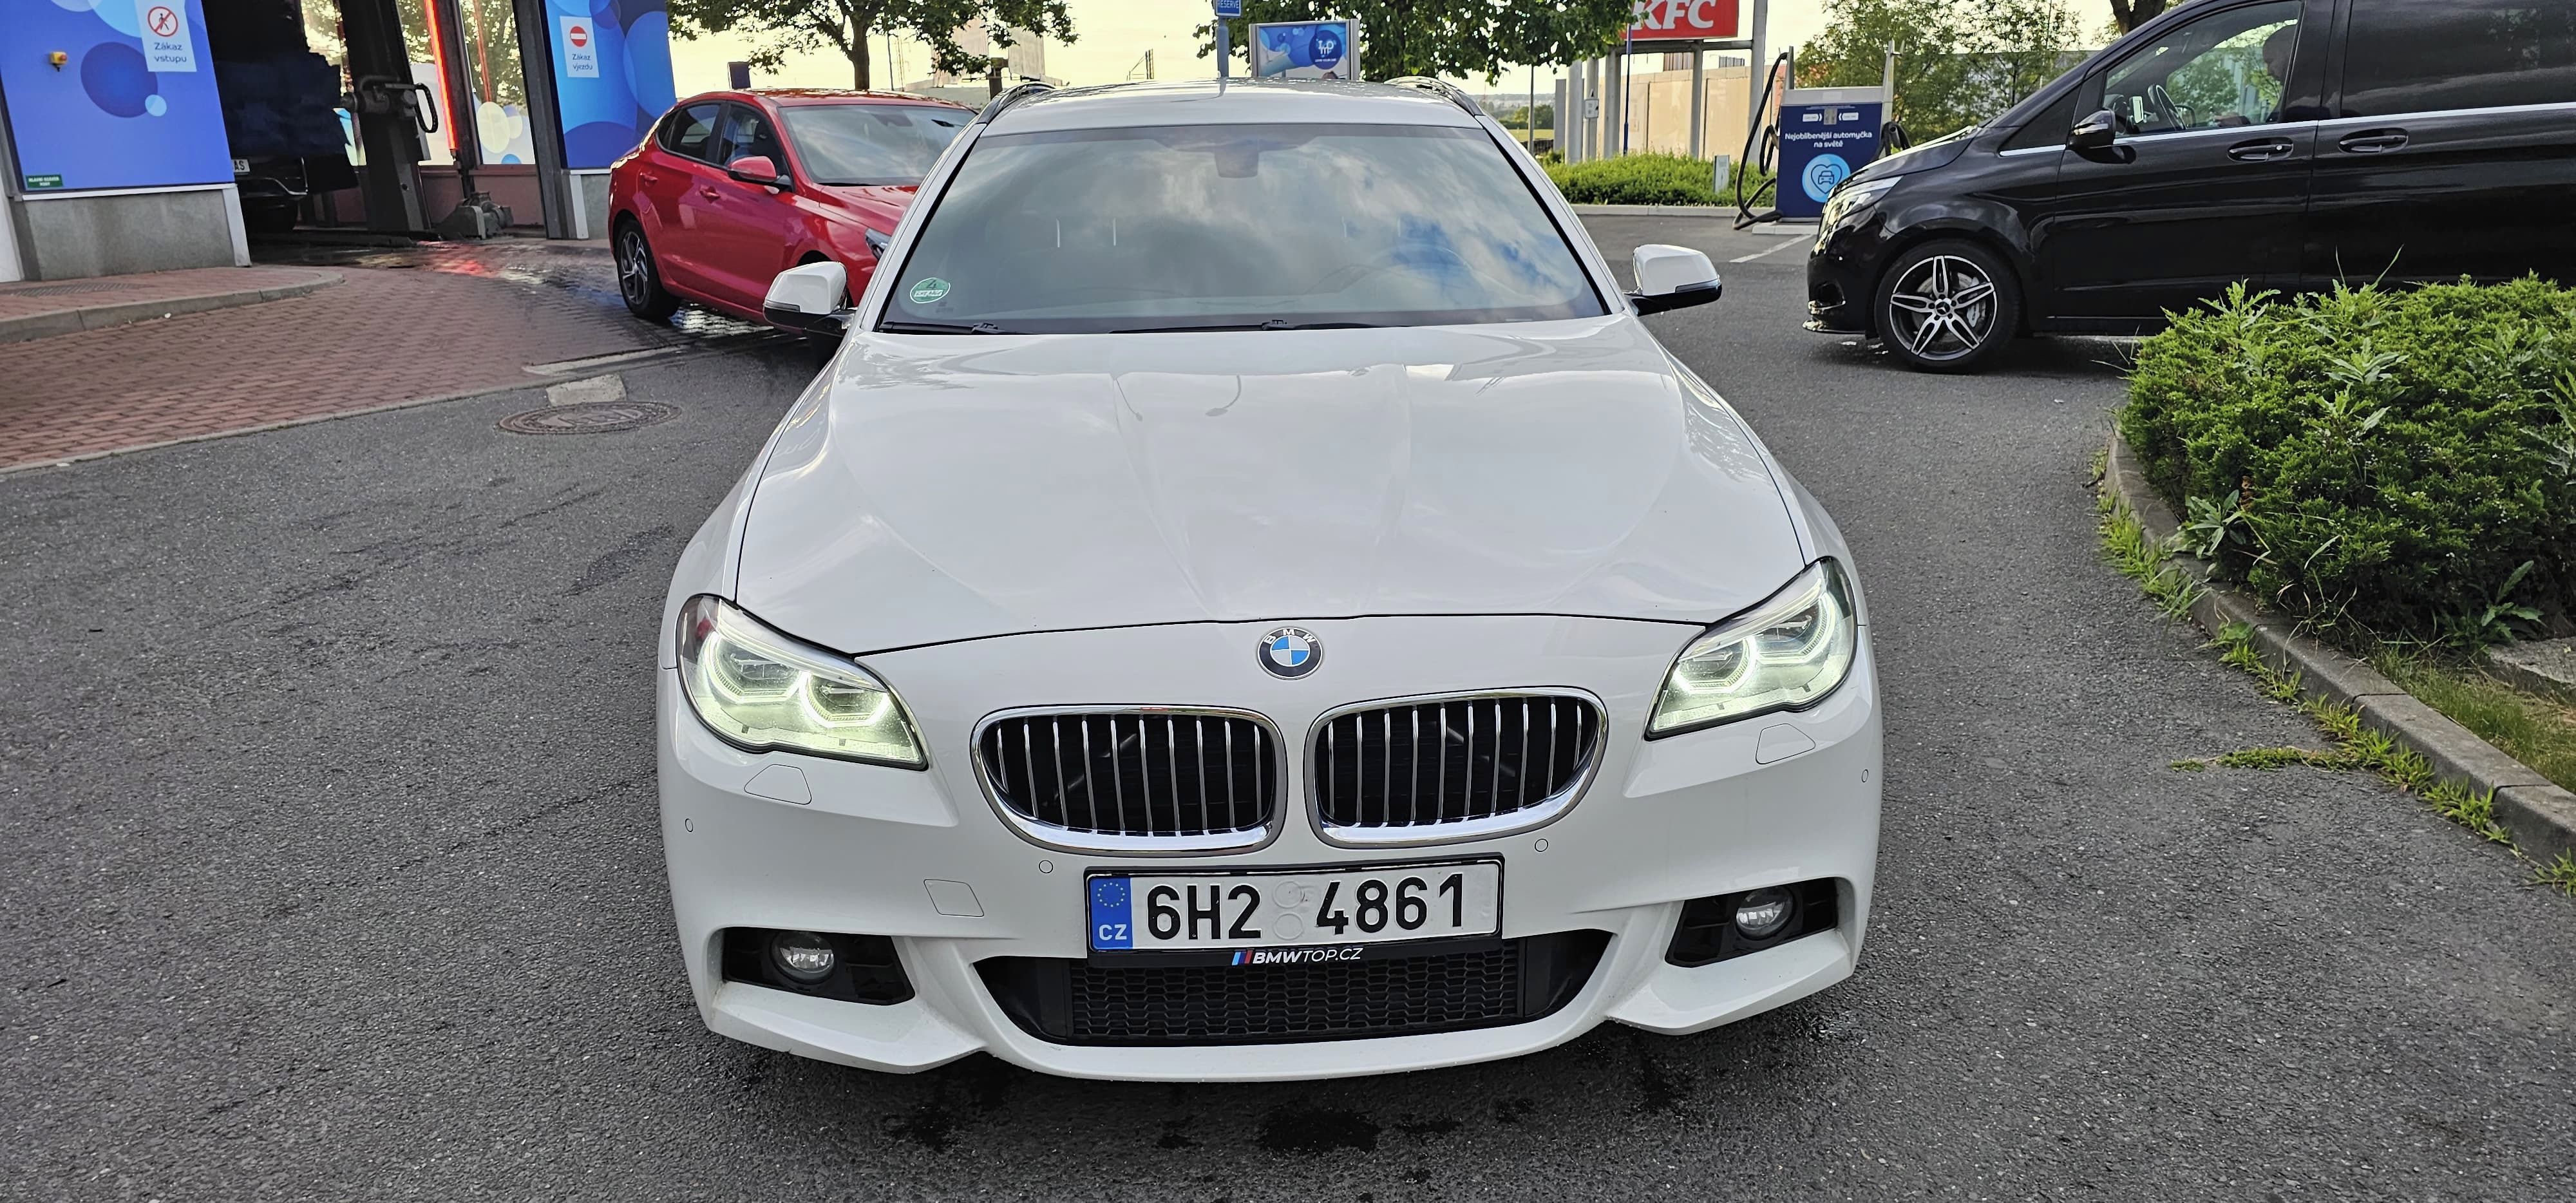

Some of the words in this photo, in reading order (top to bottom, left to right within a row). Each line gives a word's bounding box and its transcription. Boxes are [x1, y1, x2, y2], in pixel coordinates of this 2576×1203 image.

[1631, 0, 1717, 30] KFC
[154, 41, 183, 51] Zákaz
[154, 55, 187, 64] vstupu
[573, 63, 593, 71] vjezdu
[1833, 131, 1873, 140] automyčka
[927, 279, 938, 290] 4
[1264, 629, 1316, 645] BMW
[1099, 924, 1127, 941] CZ
[1147, 884, 1262, 940] 6H2
[1315, 873, 1463, 935] 4861
[1253, 947, 1364, 964] BMWTOP.CZ
